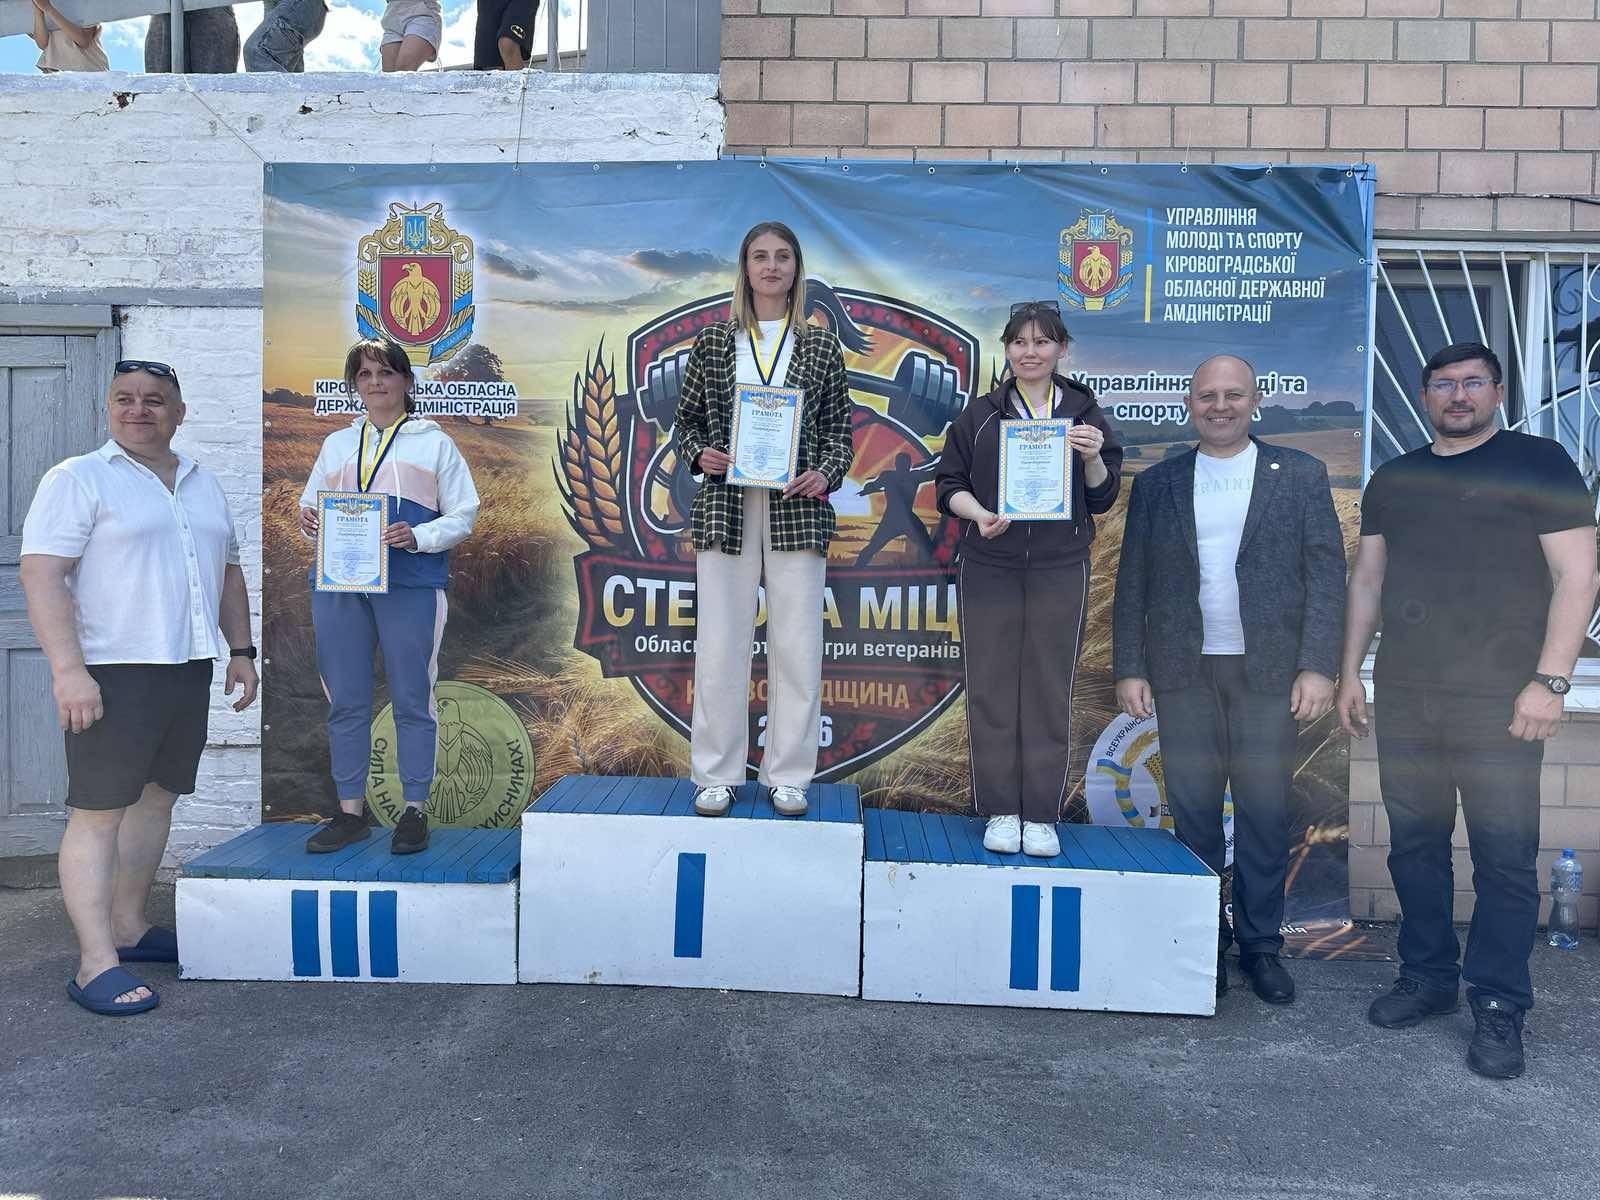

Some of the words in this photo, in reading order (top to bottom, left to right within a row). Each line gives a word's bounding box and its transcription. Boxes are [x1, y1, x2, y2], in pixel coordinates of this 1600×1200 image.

[1166, 207, 1257, 226] УПРАВЛІННЯ
[1166, 232, 1223, 250] МОЛОДІ
[1226, 232, 1245, 249] ТА
[1248, 232, 1303, 250] СПОРТУ
[1165, 252, 1296, 274] КІРОВОГРАДСЬКОЇ
[1164, 276, 1236, 298] ОБЛАСНОЇ
[1239, 277, 1326, 299] ДЕРЖАВНОЇ
[1164, 303, 1272, 324] АМДІНІСТРАЦІЇ
[447, 383, 516, 396] ОБЛАСНА
[1282, 378, 1305, 392] та
[316, 399, 369, 414] ДЕРЖА
[414, 401, 516, 417] ДМІНІСТРАЦІЯ
[1116, 404, 1188, 424] спорту
[859, 584, 961, 642] МІЦ
[635, 635, 698, 654] Облас
[825, 642, 857, 661] гри
[863, 641, 961, 662] ветеранів
[370, 737, 388, 789] СИЛА
